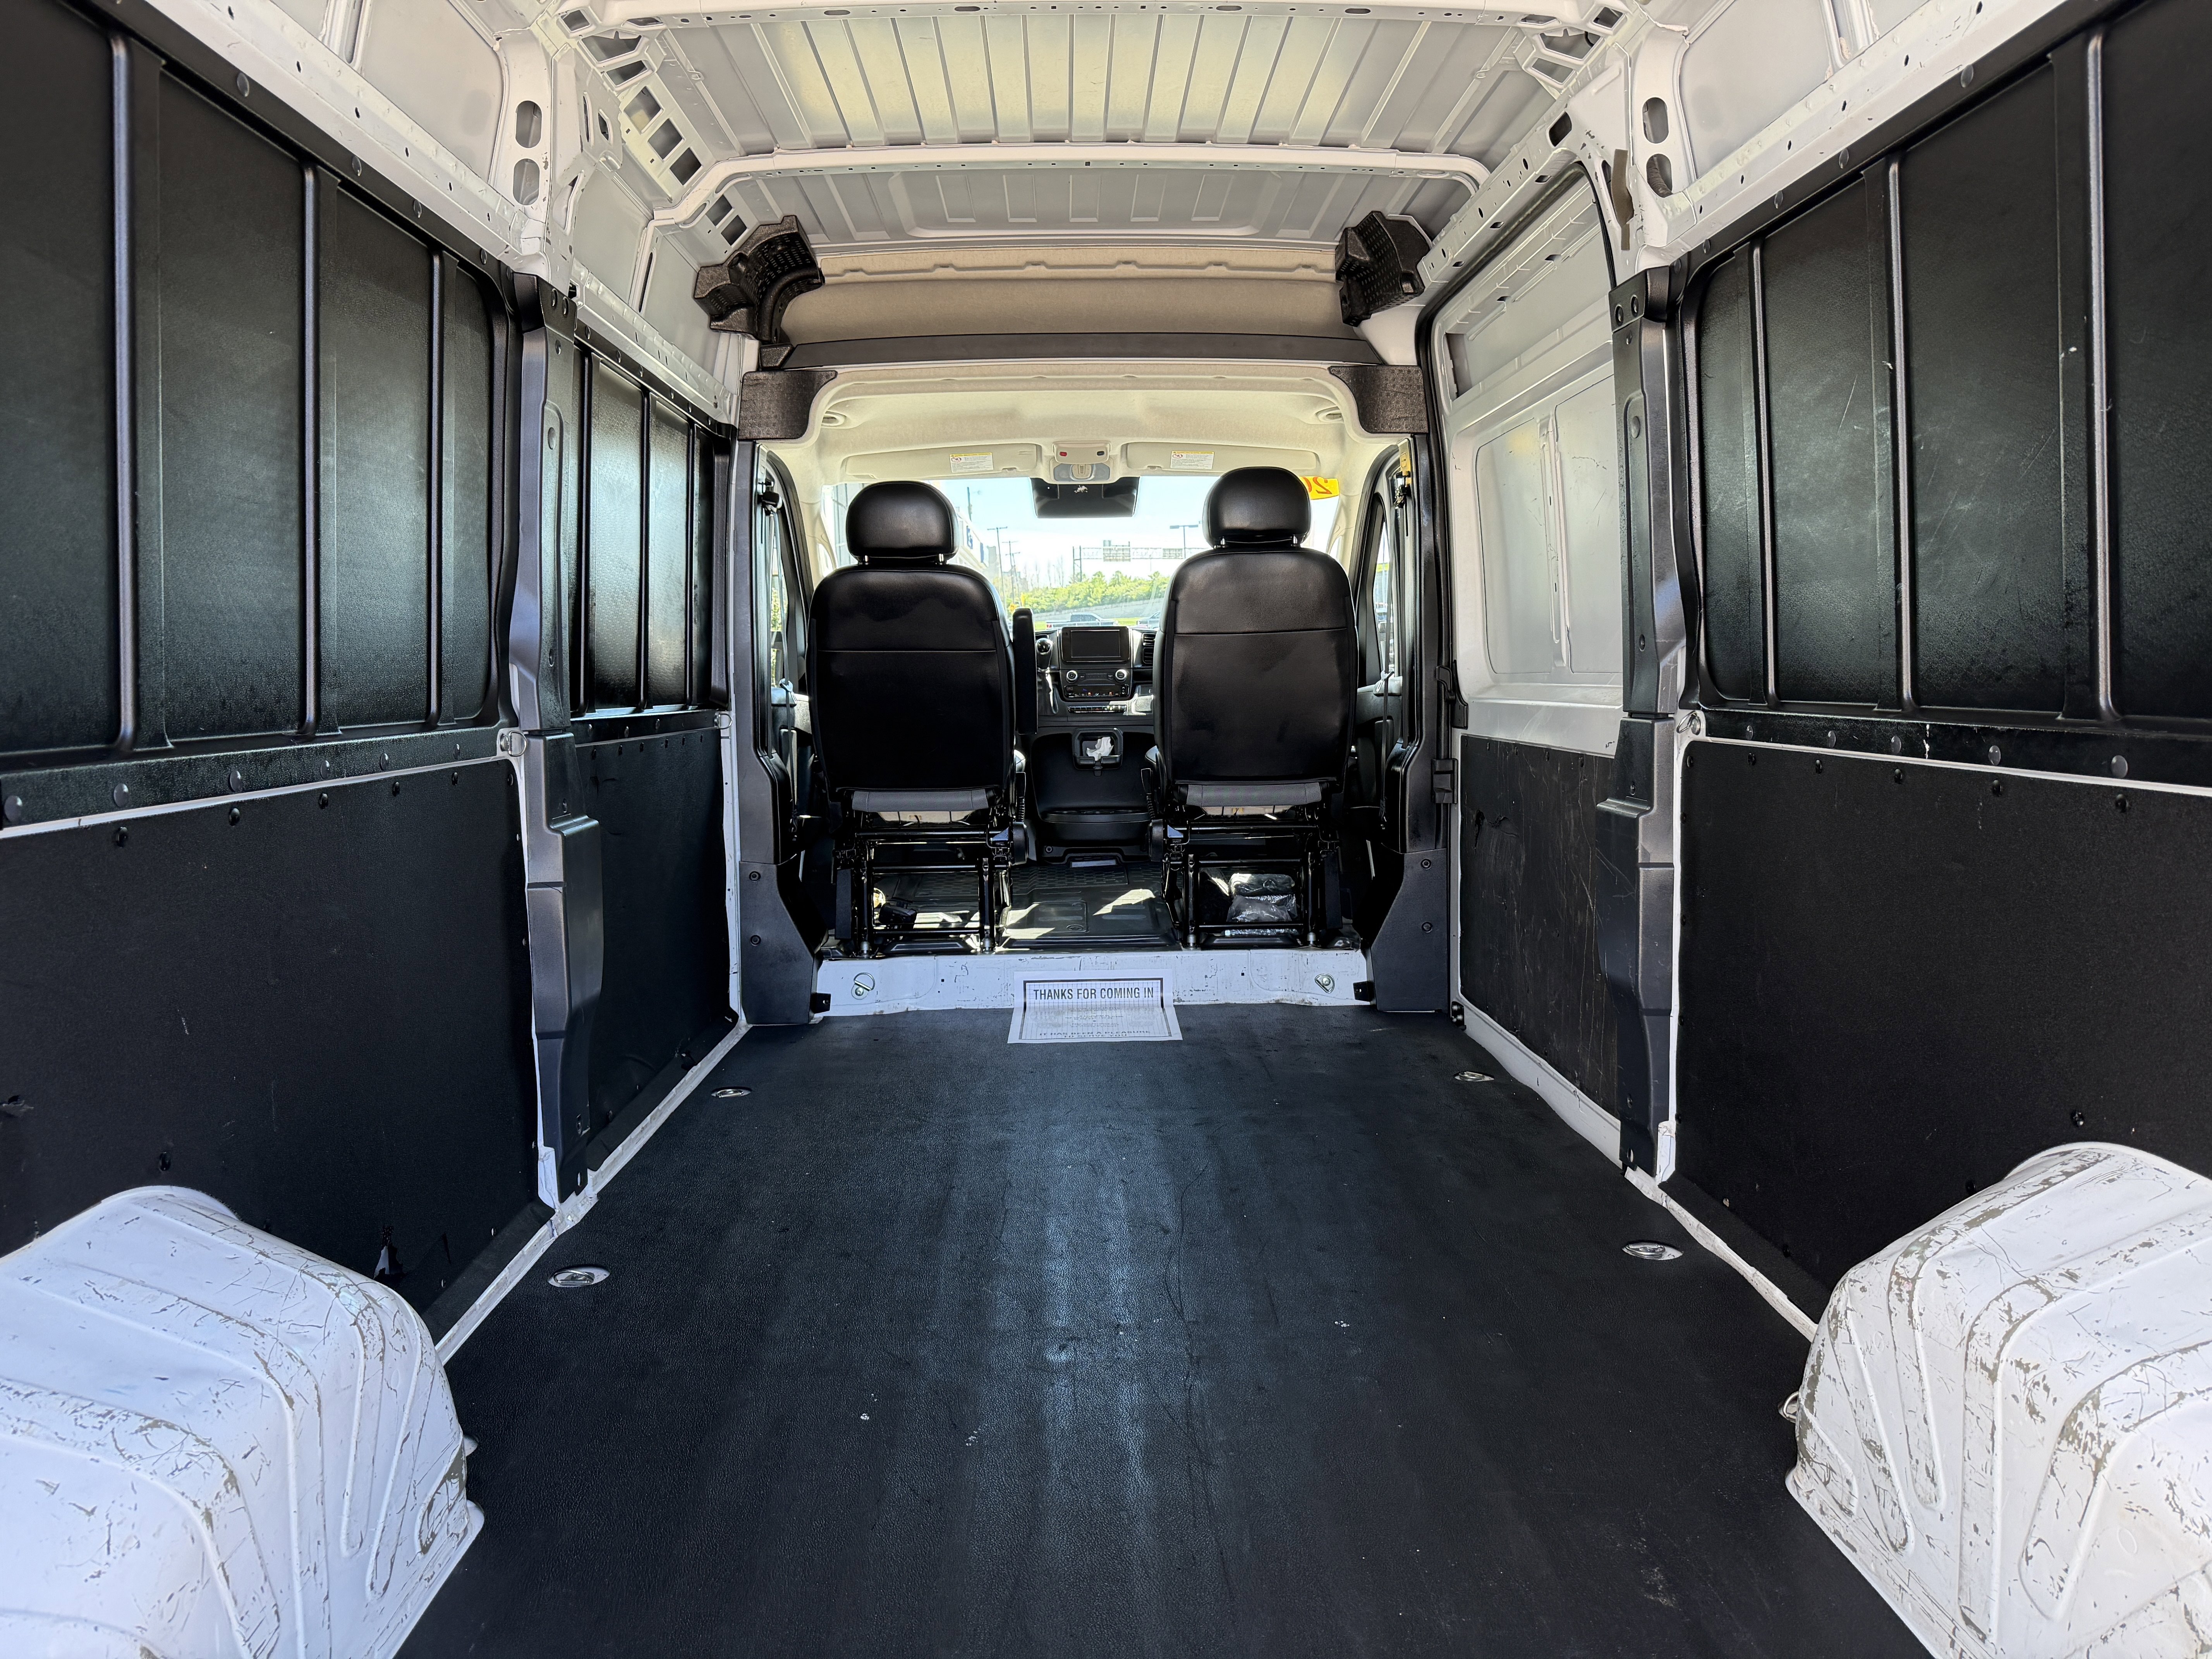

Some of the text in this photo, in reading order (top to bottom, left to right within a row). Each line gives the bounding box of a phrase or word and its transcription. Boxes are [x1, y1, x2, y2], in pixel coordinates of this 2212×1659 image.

[1033, 987, 1154, 1000] THANKS FOR COMING IN
